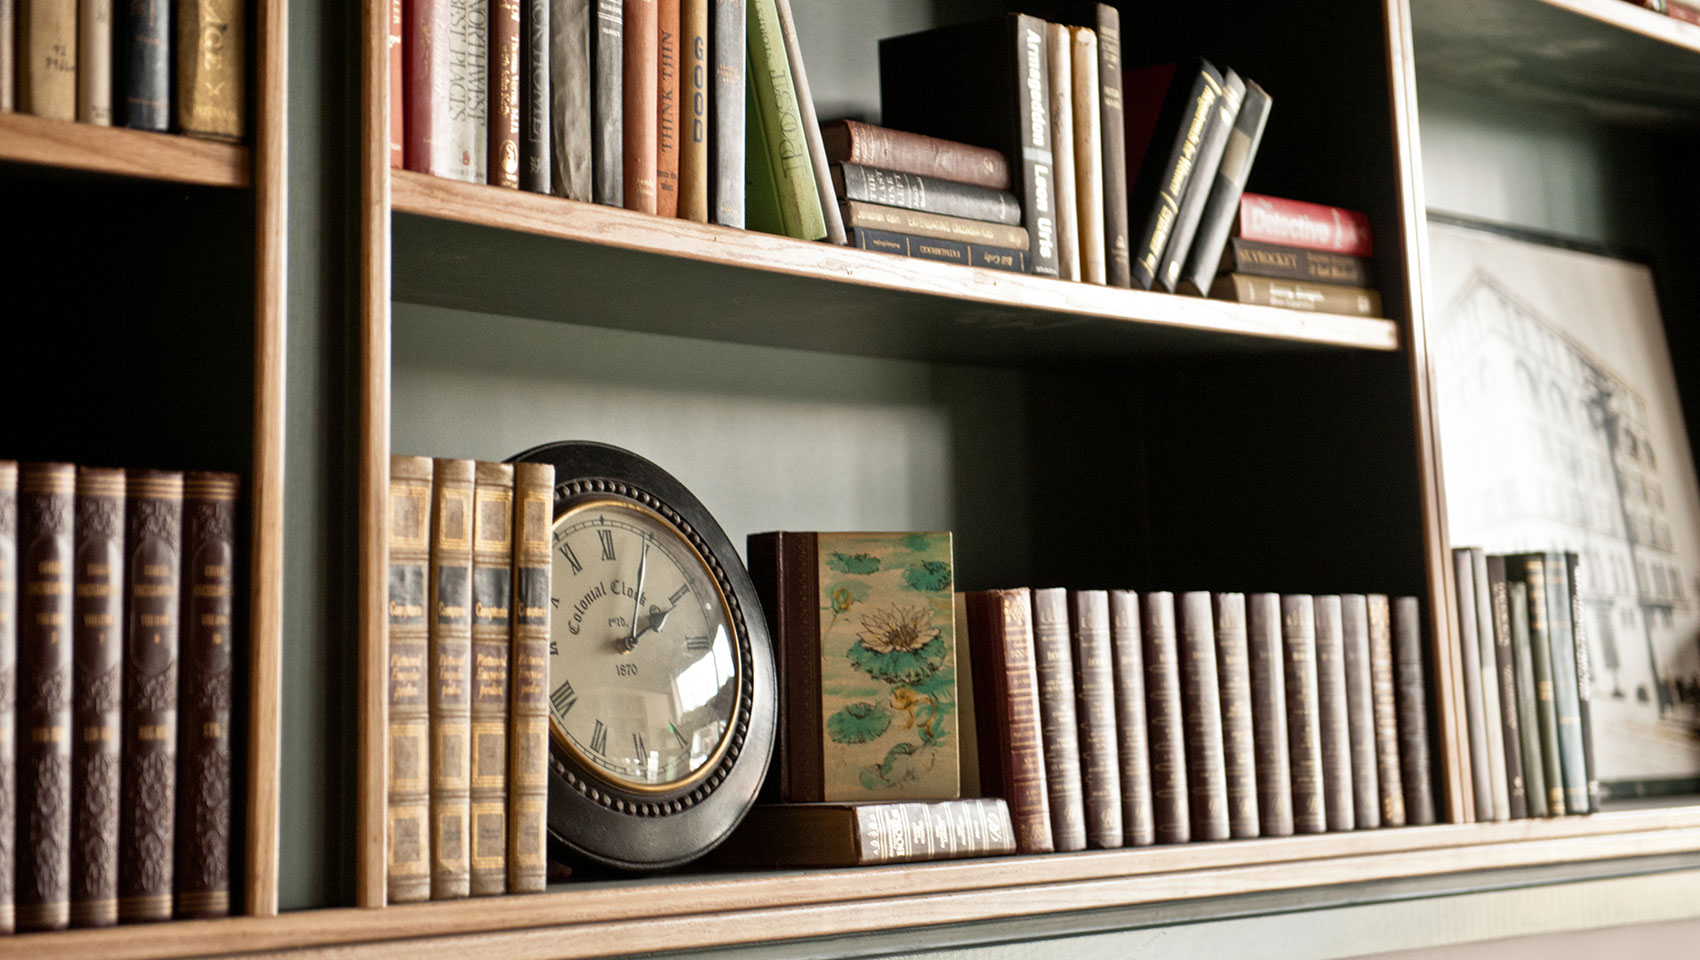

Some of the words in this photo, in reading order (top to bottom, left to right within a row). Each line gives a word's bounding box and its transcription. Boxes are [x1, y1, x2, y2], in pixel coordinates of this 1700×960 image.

[662, 30, 673, 81] THIN
[449, 50, 466, 122] PLACES
[533, 49, 546, 135] HOME
[693, 36, 704, 144] GOOD
[1026, 28, 1045, 148] Armageddon
[662, 88, 673, 153] THINK
[867, 173, 876, 200] THE
[875, 169, 886, 202] LAST
[885, 177, 895, 204] ONE
[894, 174, 904, 205] LEFT
[1034, 164, 1049, 212] Leon
[1037, 217, 1052, 259] Uris
[1251, 206, 1330, 243] Detective
[919, 246, 961, 259] FATHERHOOD
[558, 542, 583, 576] XI
[597, 529, 616, 561] XII
[568, 581, 607, 636] Colonial
[668, 582, 690, 608] II
[615, 663, 639, 677] 1870
[549, 679, 579, 720] VIII
[589, 718, 608, 757] VII
